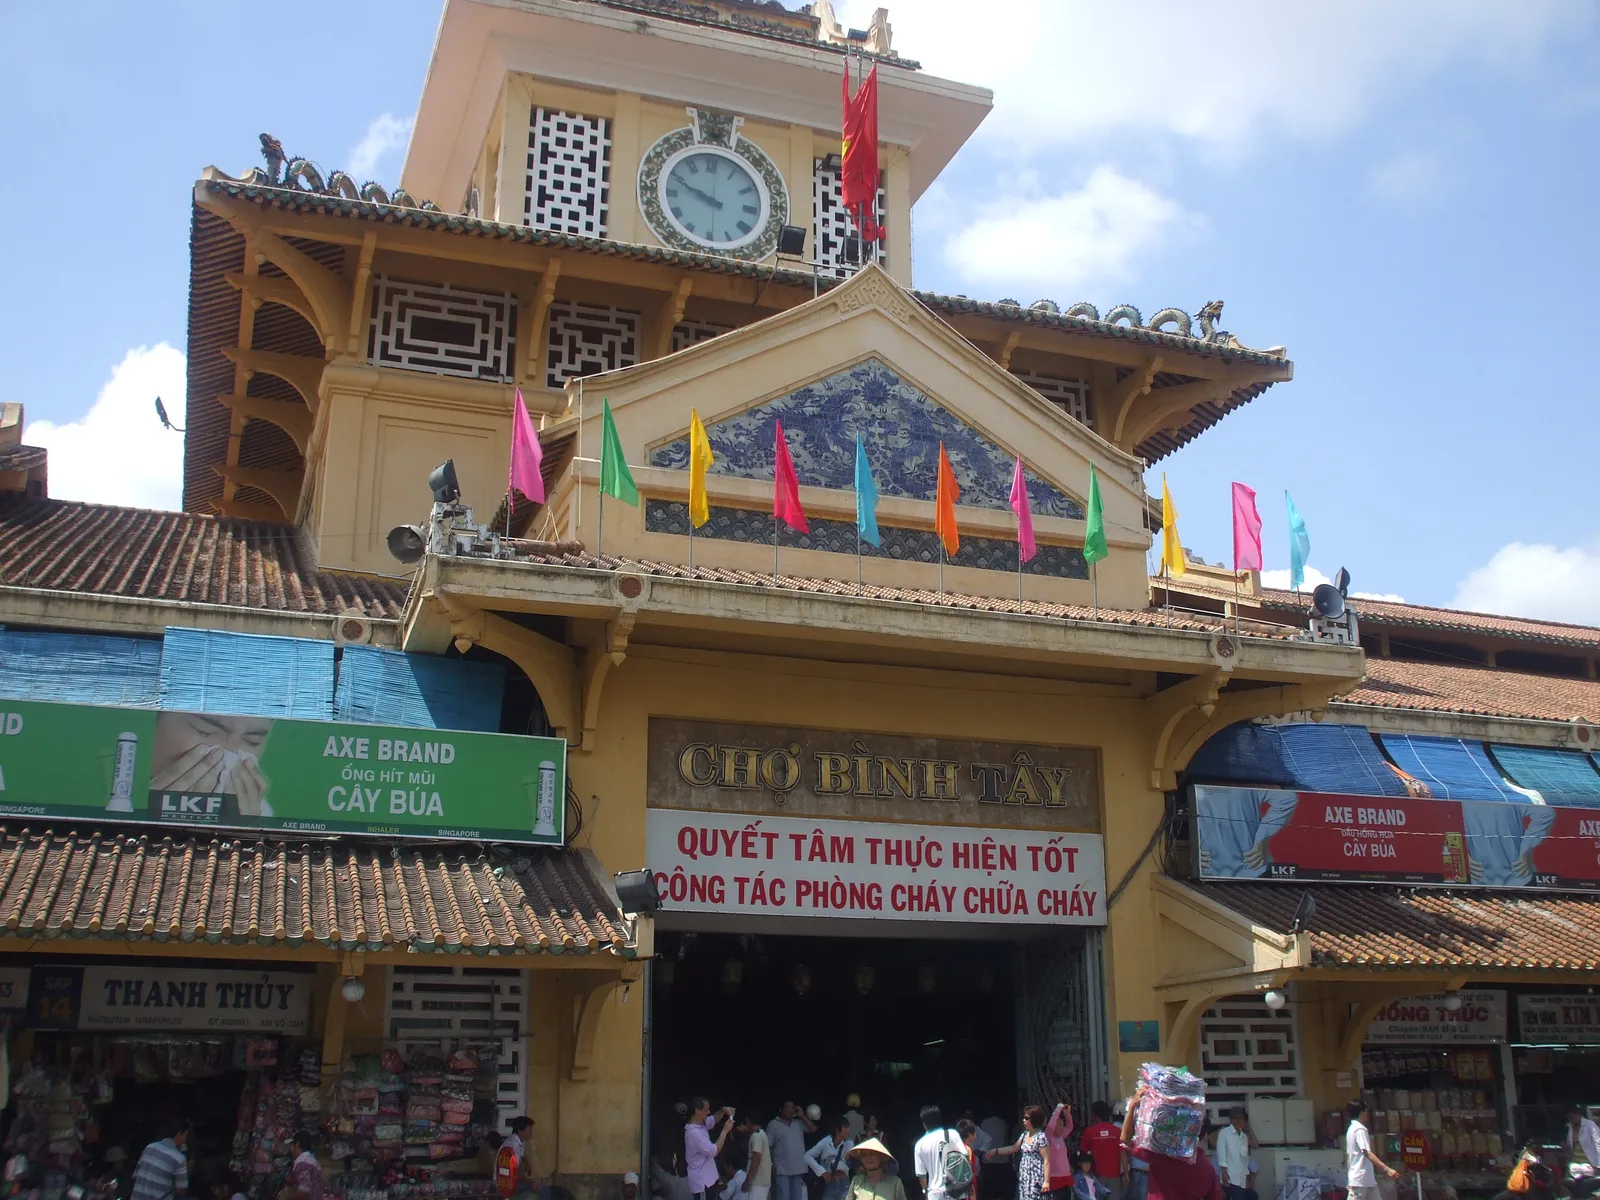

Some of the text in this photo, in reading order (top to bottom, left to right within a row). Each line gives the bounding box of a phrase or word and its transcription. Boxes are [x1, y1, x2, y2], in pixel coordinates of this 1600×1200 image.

[323, 735, 455, 765] AXE BRAND
[342, 763, 436, 786] ỐNG HÍT MŨI
[679, 739, 1073, 807] CHỢ BÌNH TÂY
[161, 794, 222, 813] LKF
[328, 784, 445, 817] CÂY BÚA
[282, 821, 326, 831] AXE BRAND
[1324, 806, 1406, 826] AXE BRAND
[367, 826, 400, 834] INHALER
[438, 829, 480, 838] SINGAPORE
[677, 820, 1079, 877] QUYẾT TÂM THỰC HIỆN TỐT
[1343, 838, 1396, 858] CÂY BÚA
[1271, 865, 1297, 875] LKF
[1535, 875, 1558, 884] LKF
[654, 866, 1097, 918] CÔNG TÁC PHÒNG CHÁY CHỮA CHÁY
[103, 974, 294, 1010] THANH THỦY
[39, 996, 73, 1020] 14
